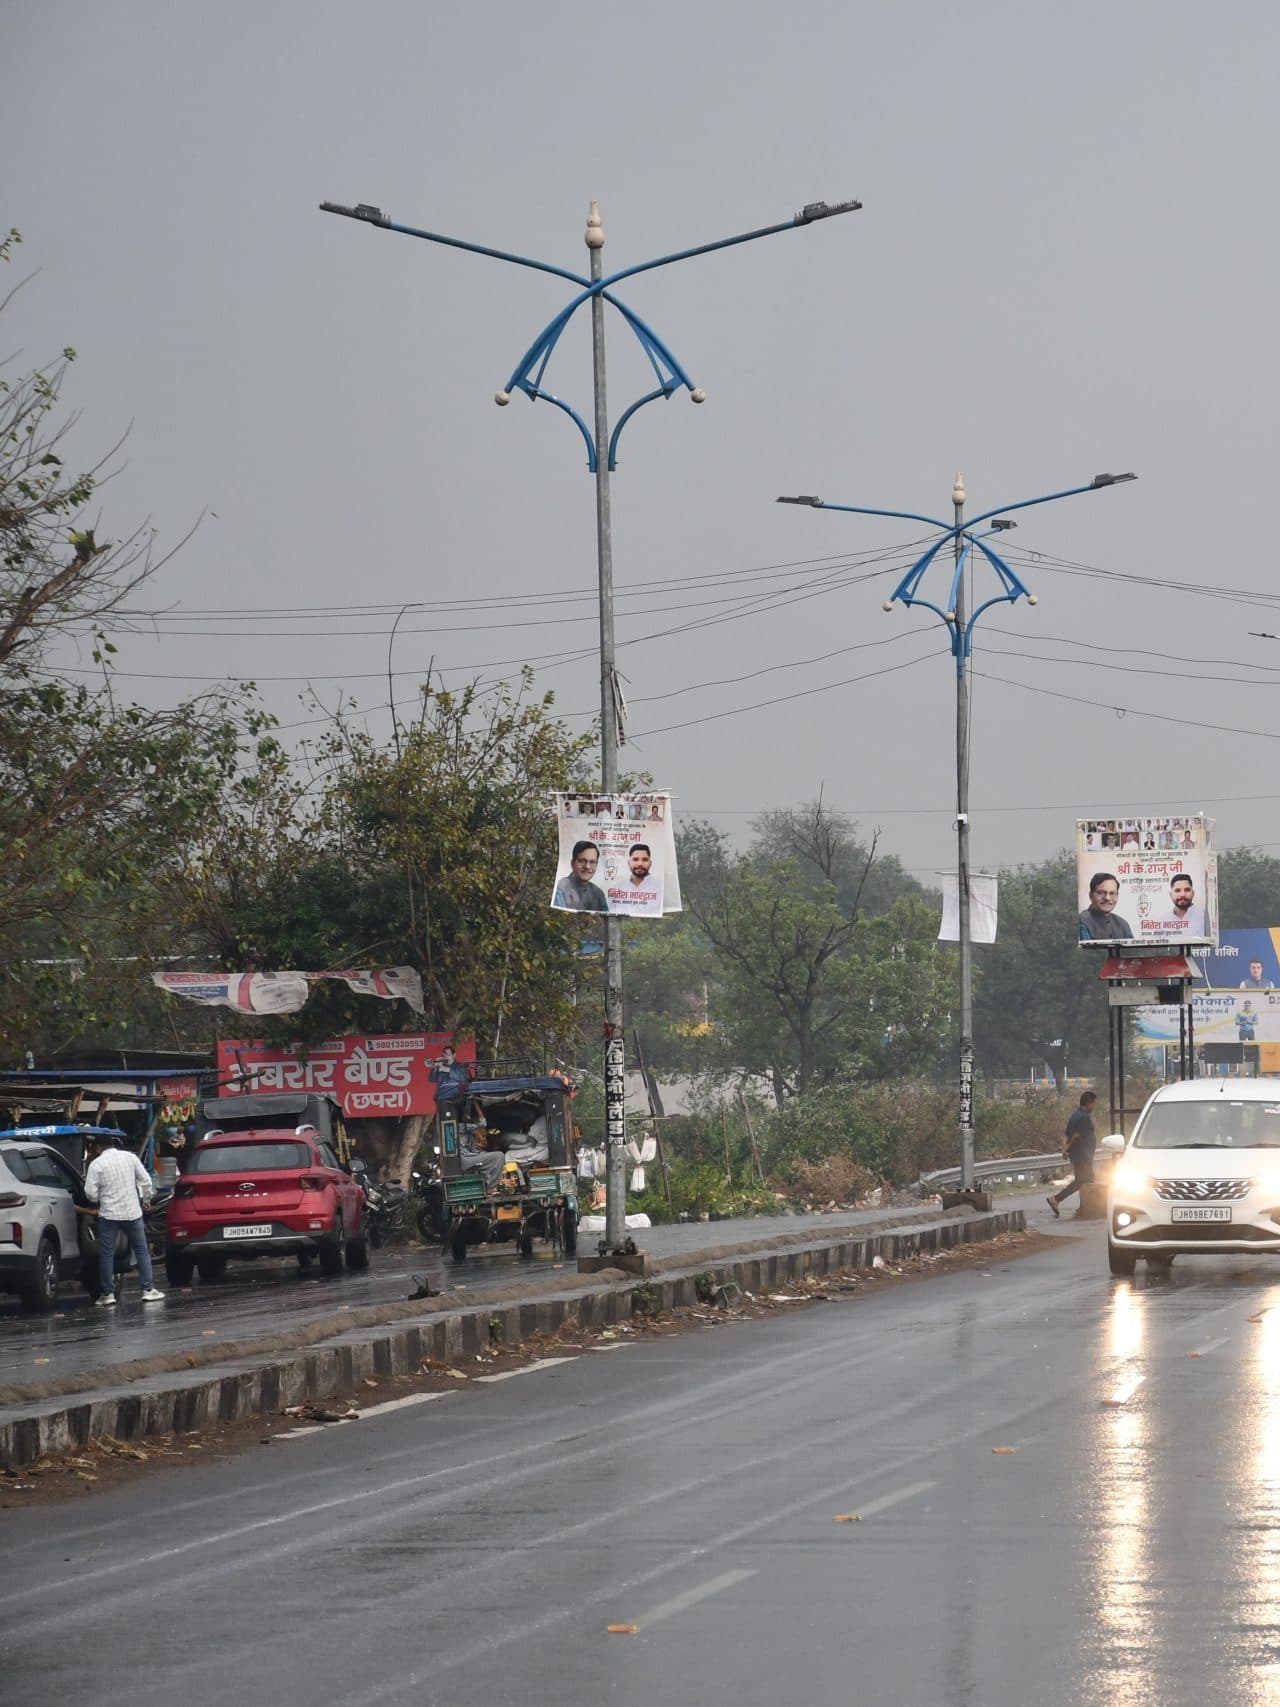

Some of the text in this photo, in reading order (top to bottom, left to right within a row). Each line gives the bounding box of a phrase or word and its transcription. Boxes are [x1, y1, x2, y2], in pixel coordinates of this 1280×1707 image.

[1118, 861, 1130, 874] श्री
[1170, 860, 1183, 873] जी
[1184, 944, 1239, 957] सली शक्ति
[225, 1046, 414, 1092] अबरार बैण्ड
[344, 1089, 412, 1114] (छपरा)
